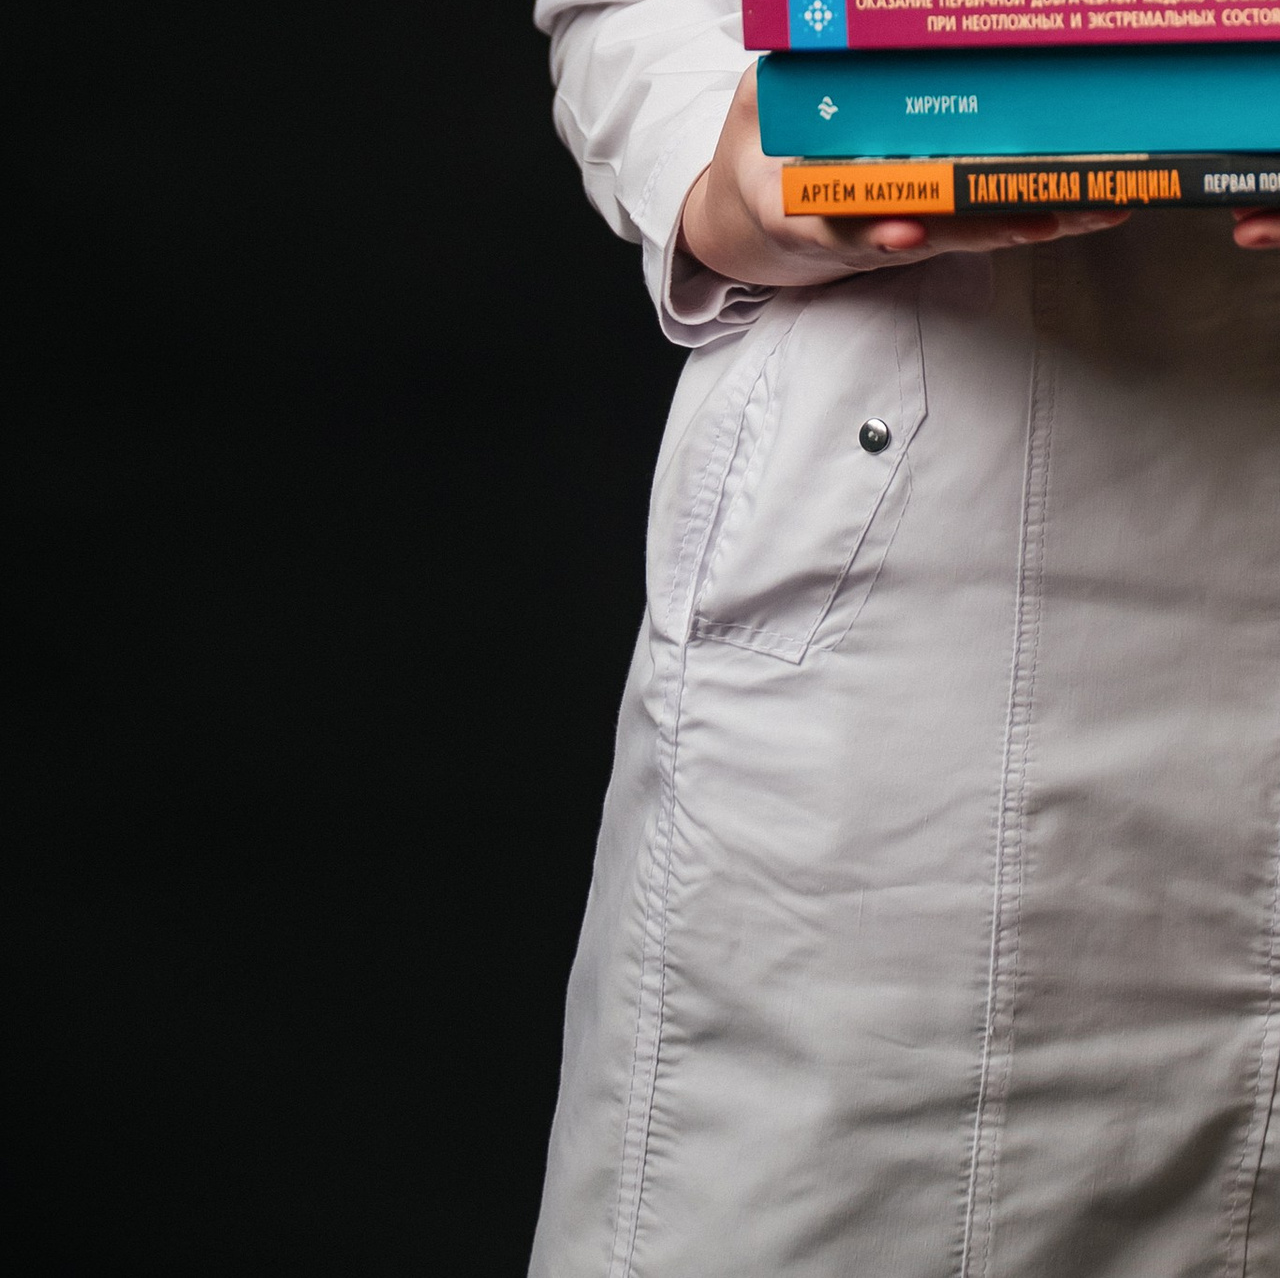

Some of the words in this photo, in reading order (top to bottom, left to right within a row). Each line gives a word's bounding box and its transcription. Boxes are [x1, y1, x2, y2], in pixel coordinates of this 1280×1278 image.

[927, 15, 957, 32] ПРИ
[962, 12, 1064, 31] НЕОТЛОЖНЫХ
[1070, 12, 1082, 29] И
[1087, 8, 1216, 28] ЭКСТРЕМАЛЬНЫХ
[905, 95, 978, 115] ХИРУРГИЯ
[801, 179, 856, 203] АРТЁМ
[865, 181, 940, 201] КАТУЛИН
[967, 171, 1080, 203] ТАКТИЧЕСКАЯ
[1087, 169, 1182, 205] МЕДИЦИНА
[1204, 173, 1256, 193] ПЕРВАЯ
